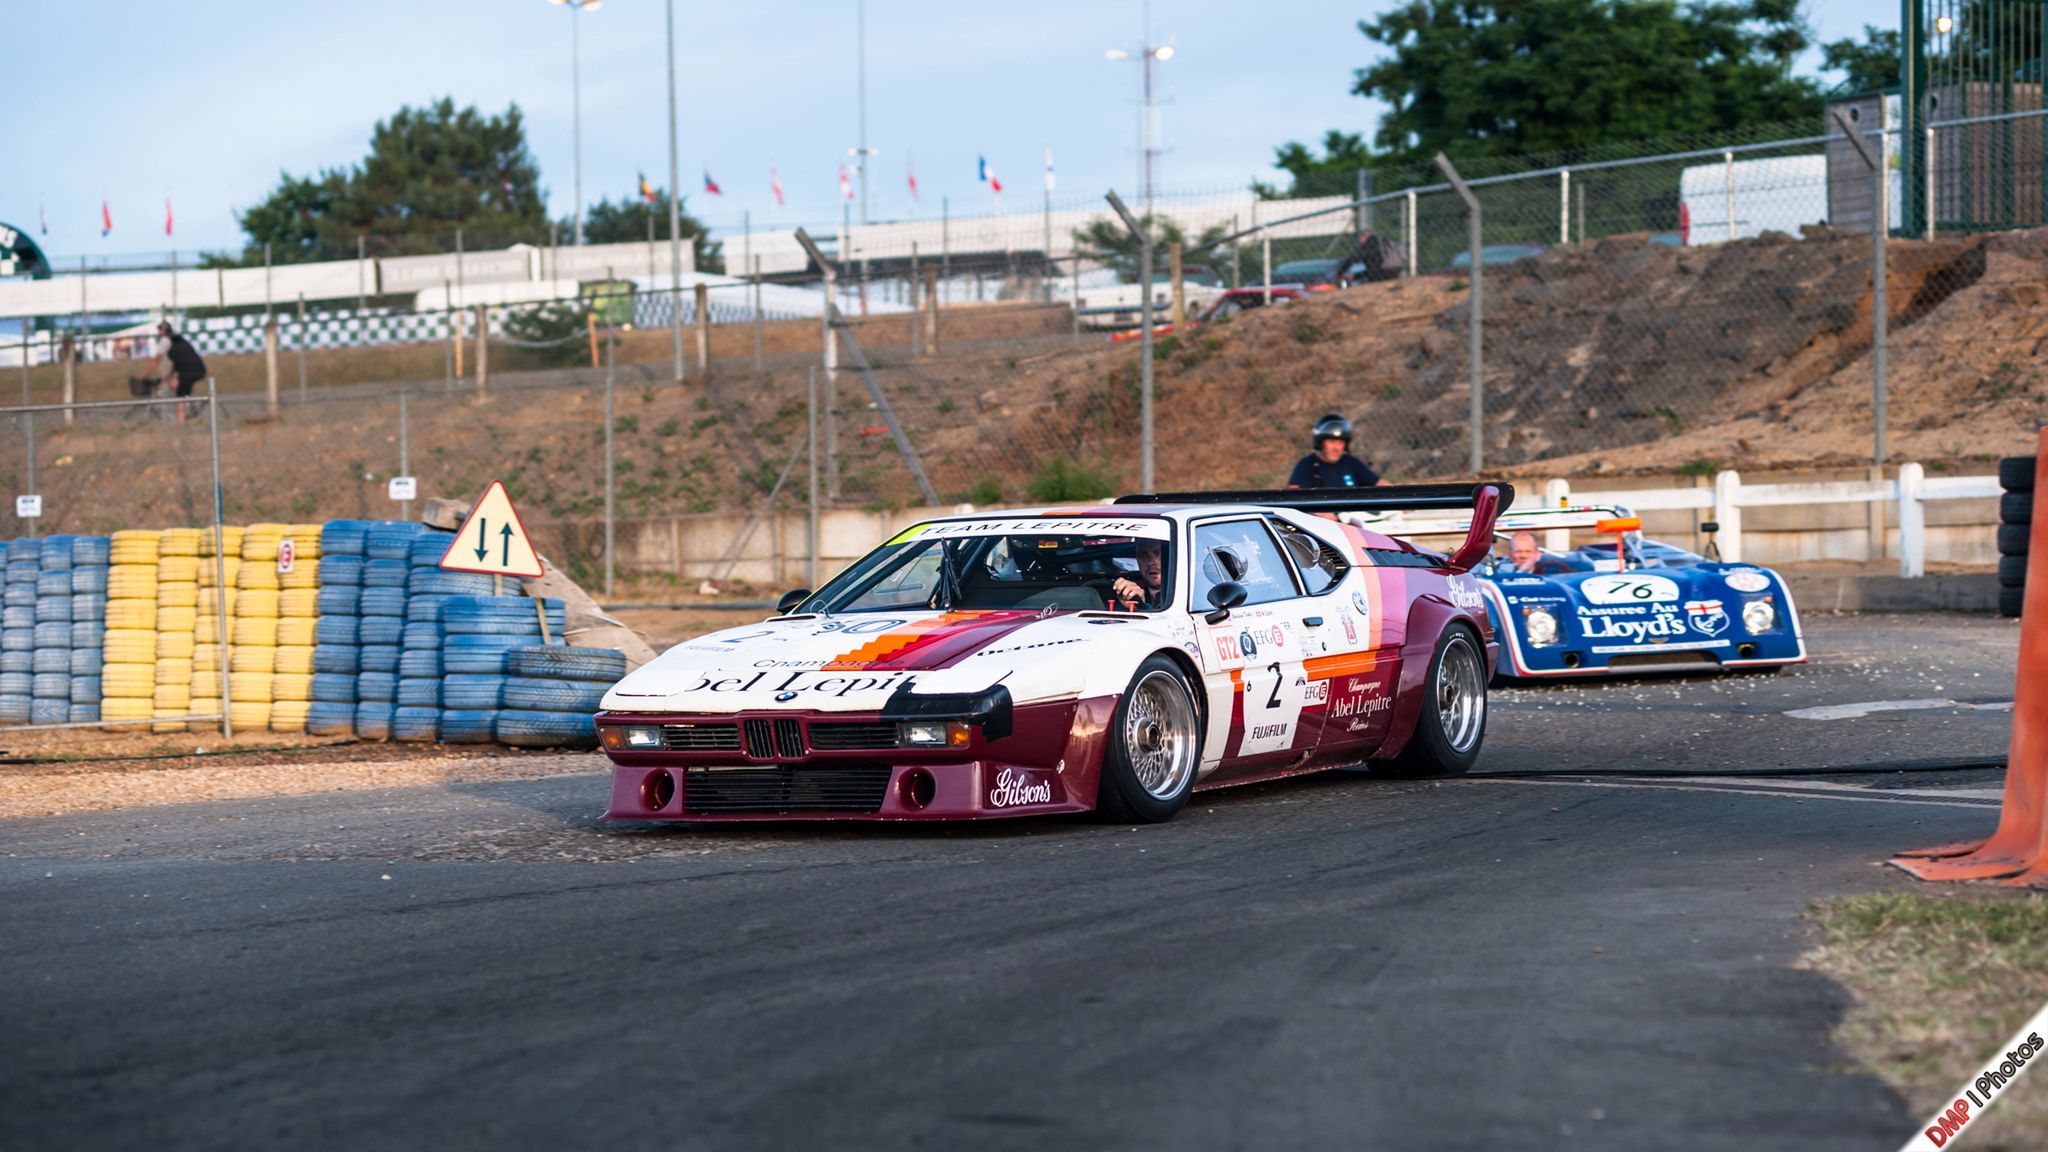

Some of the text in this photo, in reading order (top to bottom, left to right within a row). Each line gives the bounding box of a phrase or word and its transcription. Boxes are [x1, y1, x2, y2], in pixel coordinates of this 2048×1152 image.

[920, 521, 1149, 536] TEAM LEPITRE
[1607, 580, 1653, 599] 76
[1650, 602, 1680, 614] Au
[1577, 613, 1687, 644] Lloyd's
[1253, 629, 1274, 646] EFG
[1215, 635, 1240, 661] GT2
[1246, 680, 1253, 692] 6
[1265, 661, 1284, 709] 2
[1304, 685, 1320, 700] EFG
[1331, 692, 1392, 719] Abel Lepitre
[1251, 723, 1288, 740] FUJIFILM
[1346, 717, 1369, 732] Reims
